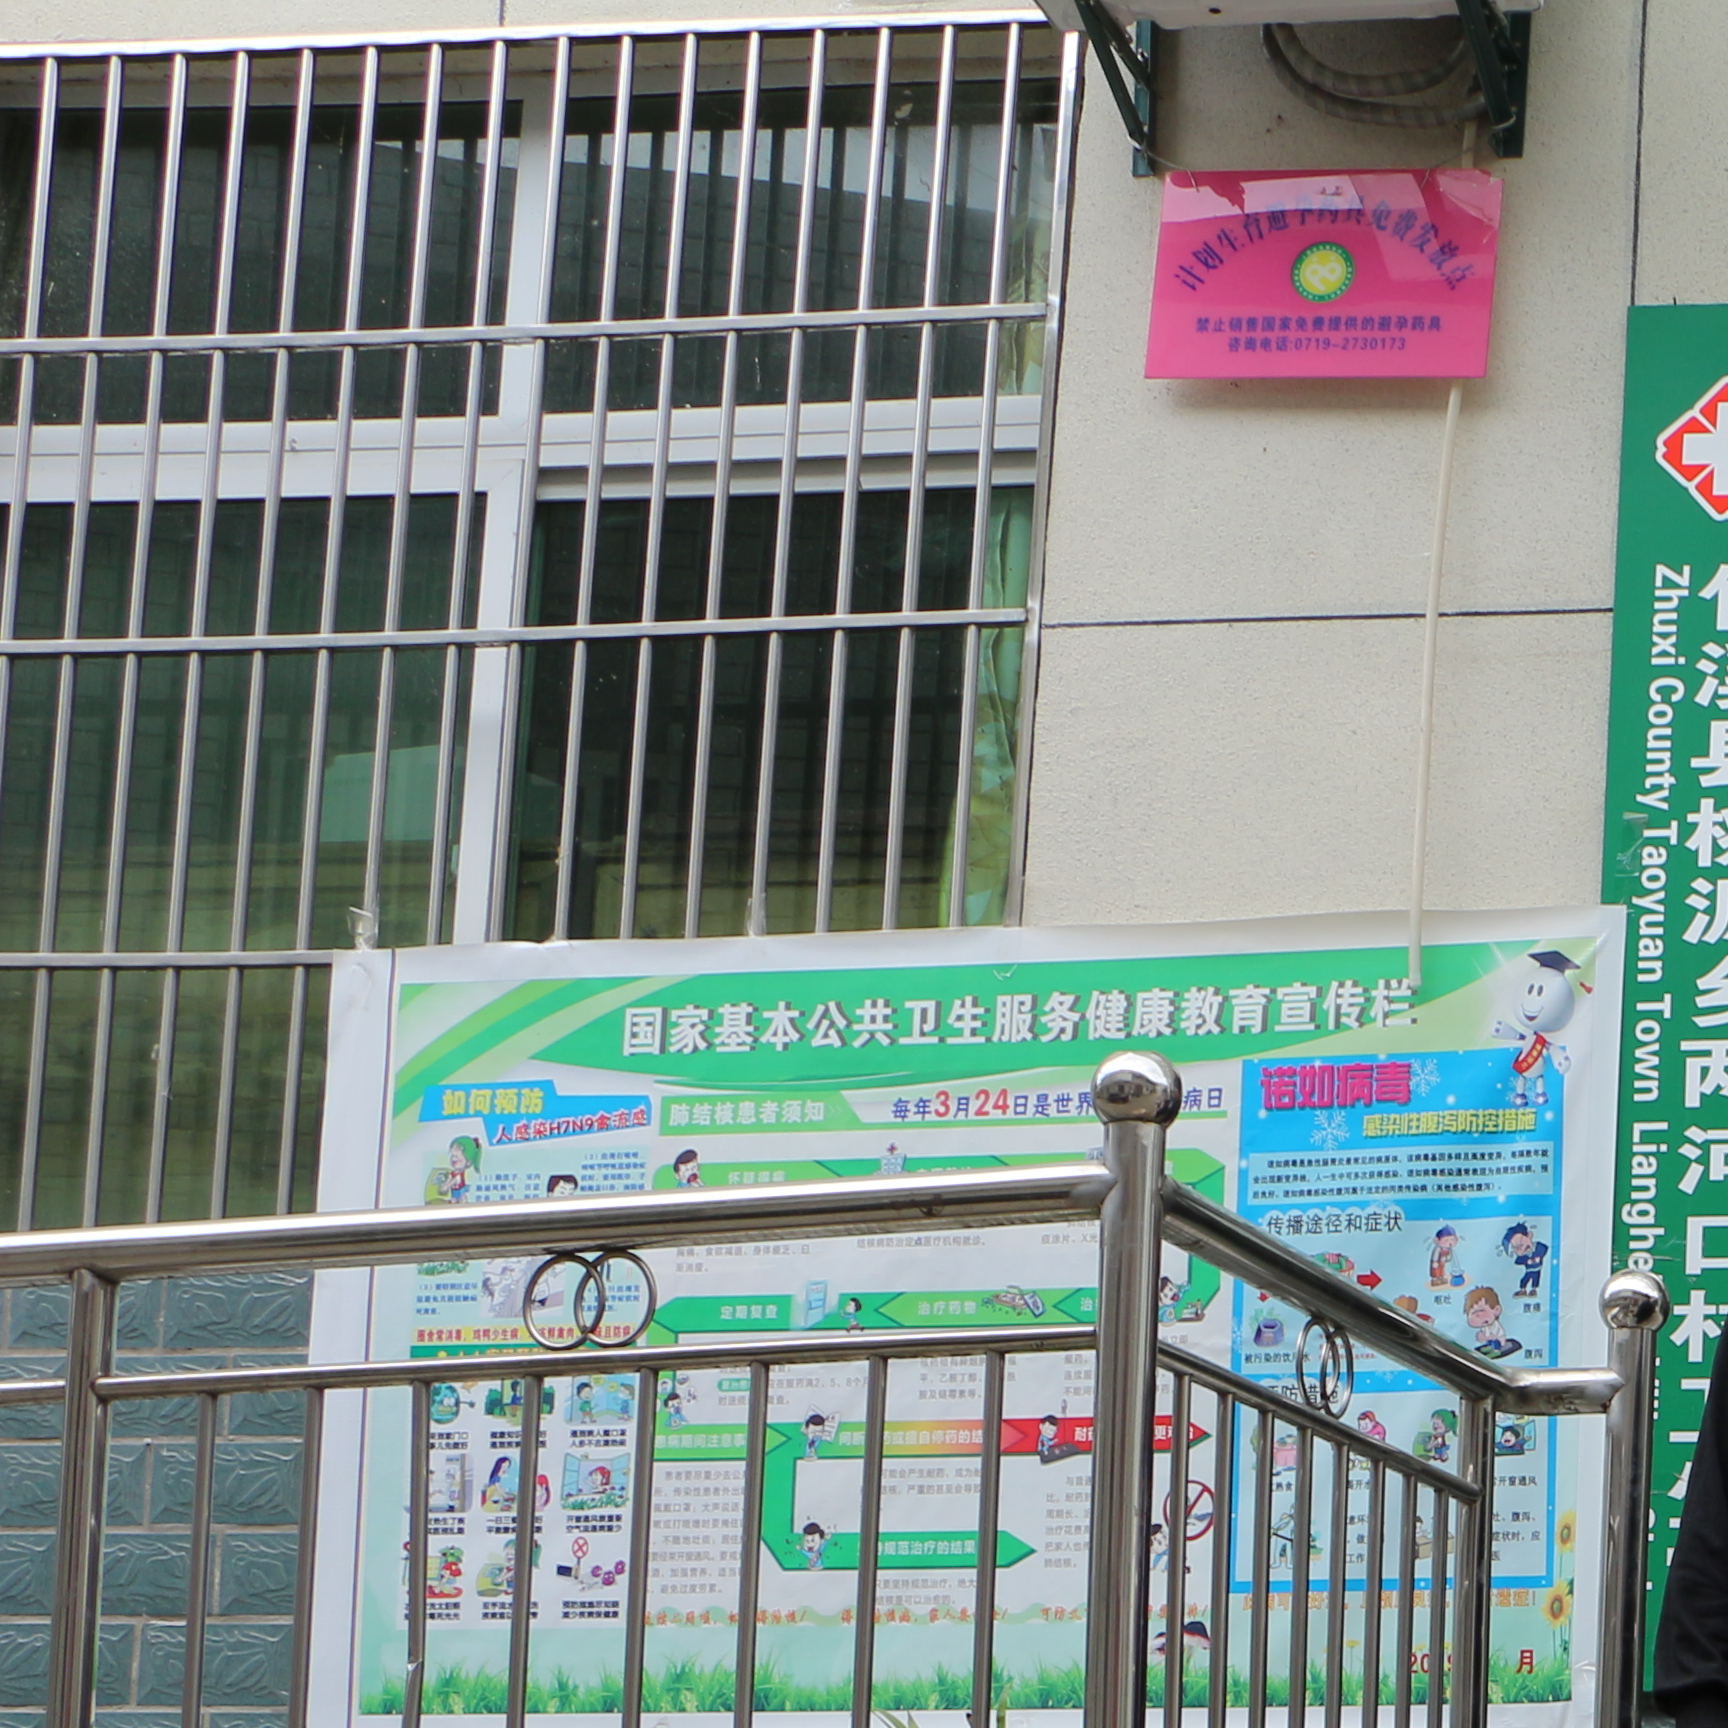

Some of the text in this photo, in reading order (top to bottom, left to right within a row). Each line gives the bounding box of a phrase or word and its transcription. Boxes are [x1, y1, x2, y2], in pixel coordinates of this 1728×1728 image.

[1621, 564, 1689, 1278] Zhuxi County Taoyuan Town Lianghe
[622, 977, 1418, 1056] 国家基本公共卫生服务健康教育宣传栏
[1260, 1062, 1412, 1110] 诺如病毒
[442, 1088, 544, 1116] 如何预防
[669, 1100, 825, 1127] 肺结核患者须知
[891, 1087, 1224, 1121] 每年3月24日是世界病日
[494, 1106, 647, 1144] 人感染H7N9禽流感
[1362, 1108, 1537, 1138] 感染性腹泻防控措施
[1267, 1211, 1403, 1237] 传播途径和症状
[720, 1304, 778, 1320] 定期复查
[918, 1301, 977, 1315] 治疗药物
